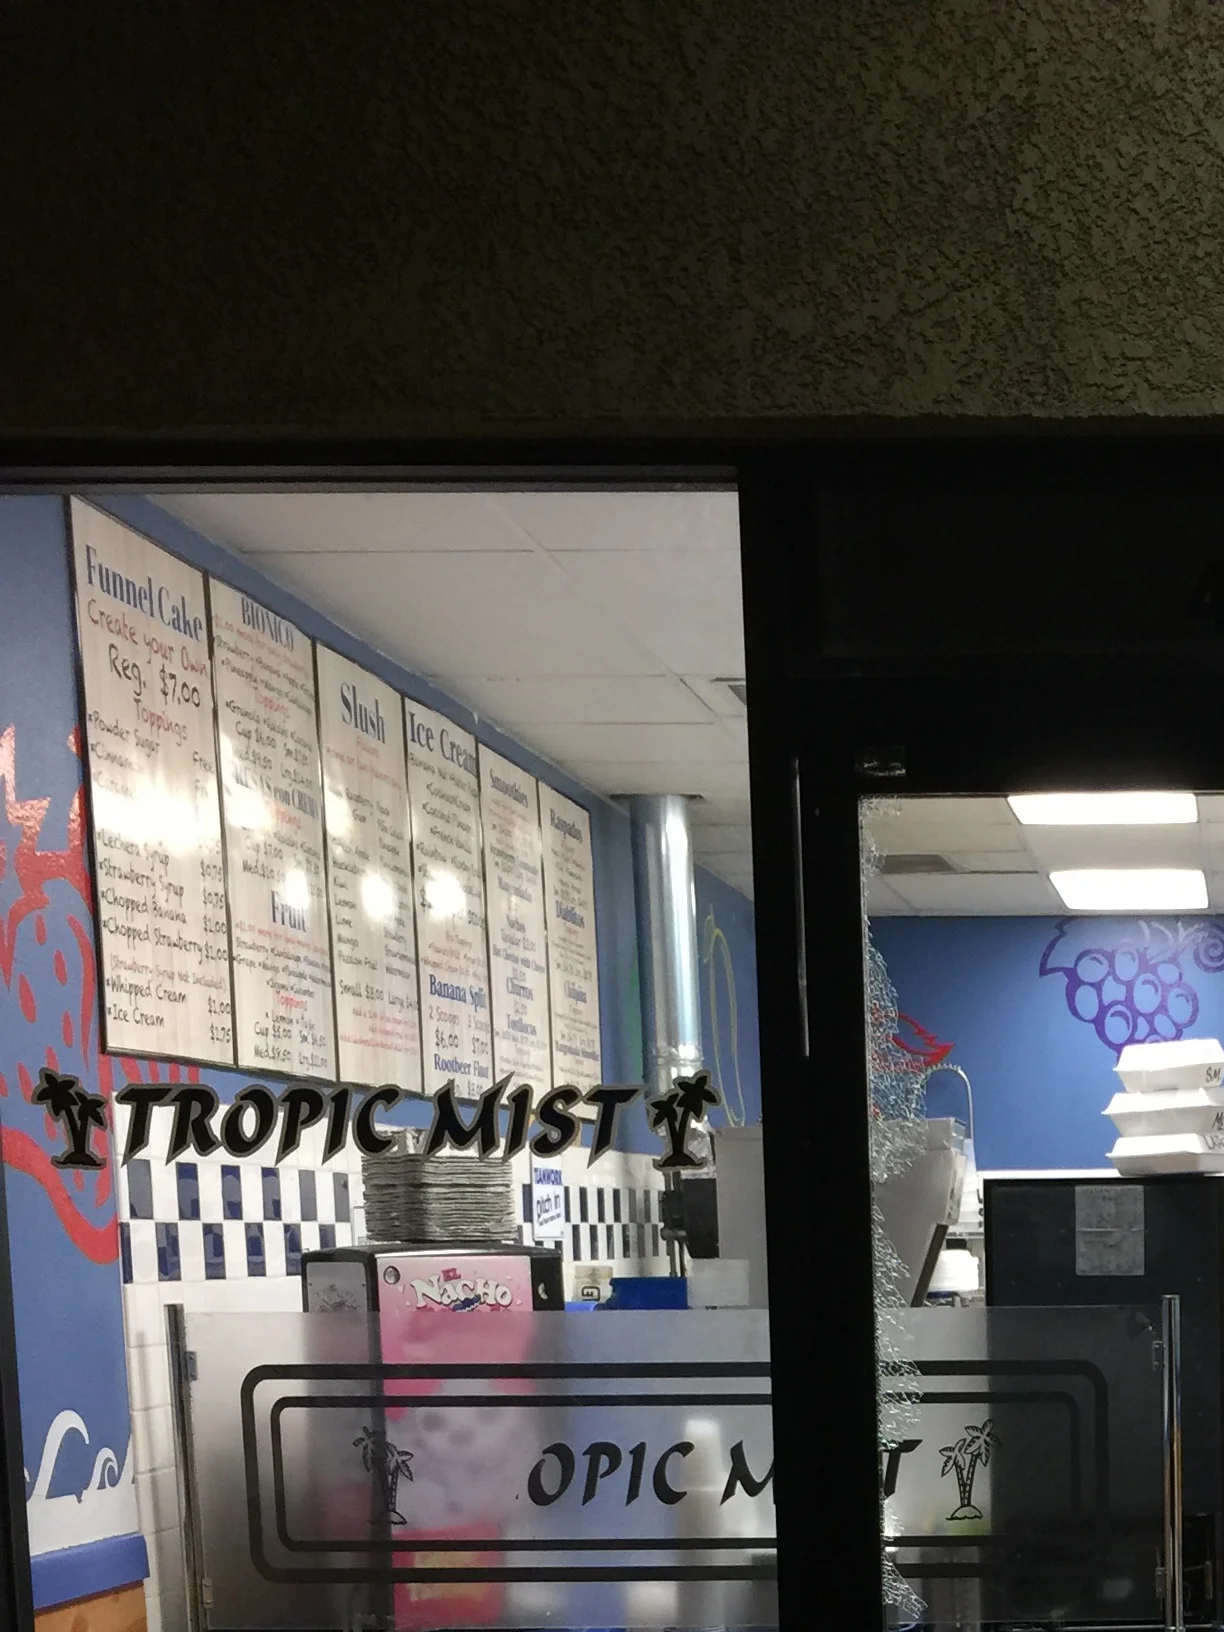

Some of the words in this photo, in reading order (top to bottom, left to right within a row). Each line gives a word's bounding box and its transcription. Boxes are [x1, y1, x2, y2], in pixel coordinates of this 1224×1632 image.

[85, 541, 154, 618] Funnel
[157, 580, 203, 644] Cake
[86, 594, 137, 645] Create
[143, 631, 175, 676] your
[241, 597, 294, 653] BIONICO
[159, 662, 201, 720] $7.00
[339, 675, 385, 745] Slush
[133, 696, 188, 750] Toppings
[408, 708, 434, 754] Ice
[489, 766, 528, 808] Smoothies
[549, 806, 583, 848] Raspados
[103, 856, 156, 899] Strawberry
[104, 883, 148, 926] Chopped
[152, 900, 186, 926] Banana
[106, 913, 150, 953] Chopped
[153, 924, 203, 965] Strawberry
[110, 973, 152, 1010] Whipped
[155, 983, 186, 1004] Cream
[207, 994, 231, 1017] $1.00
[339, 979, 362, 999] Small
[429, 973, 466, 1006] Banana
[506, 976, 533, 1001] Churros
[112, 1003, 128, 1022] Ice
[132, 1007, 164, 1028] Cream
[433, 1052, 471, 1078] Rootbeer
[116, 1082, 400, 1166] TROPIC
[422, 1072, 644, 1169] MIST
